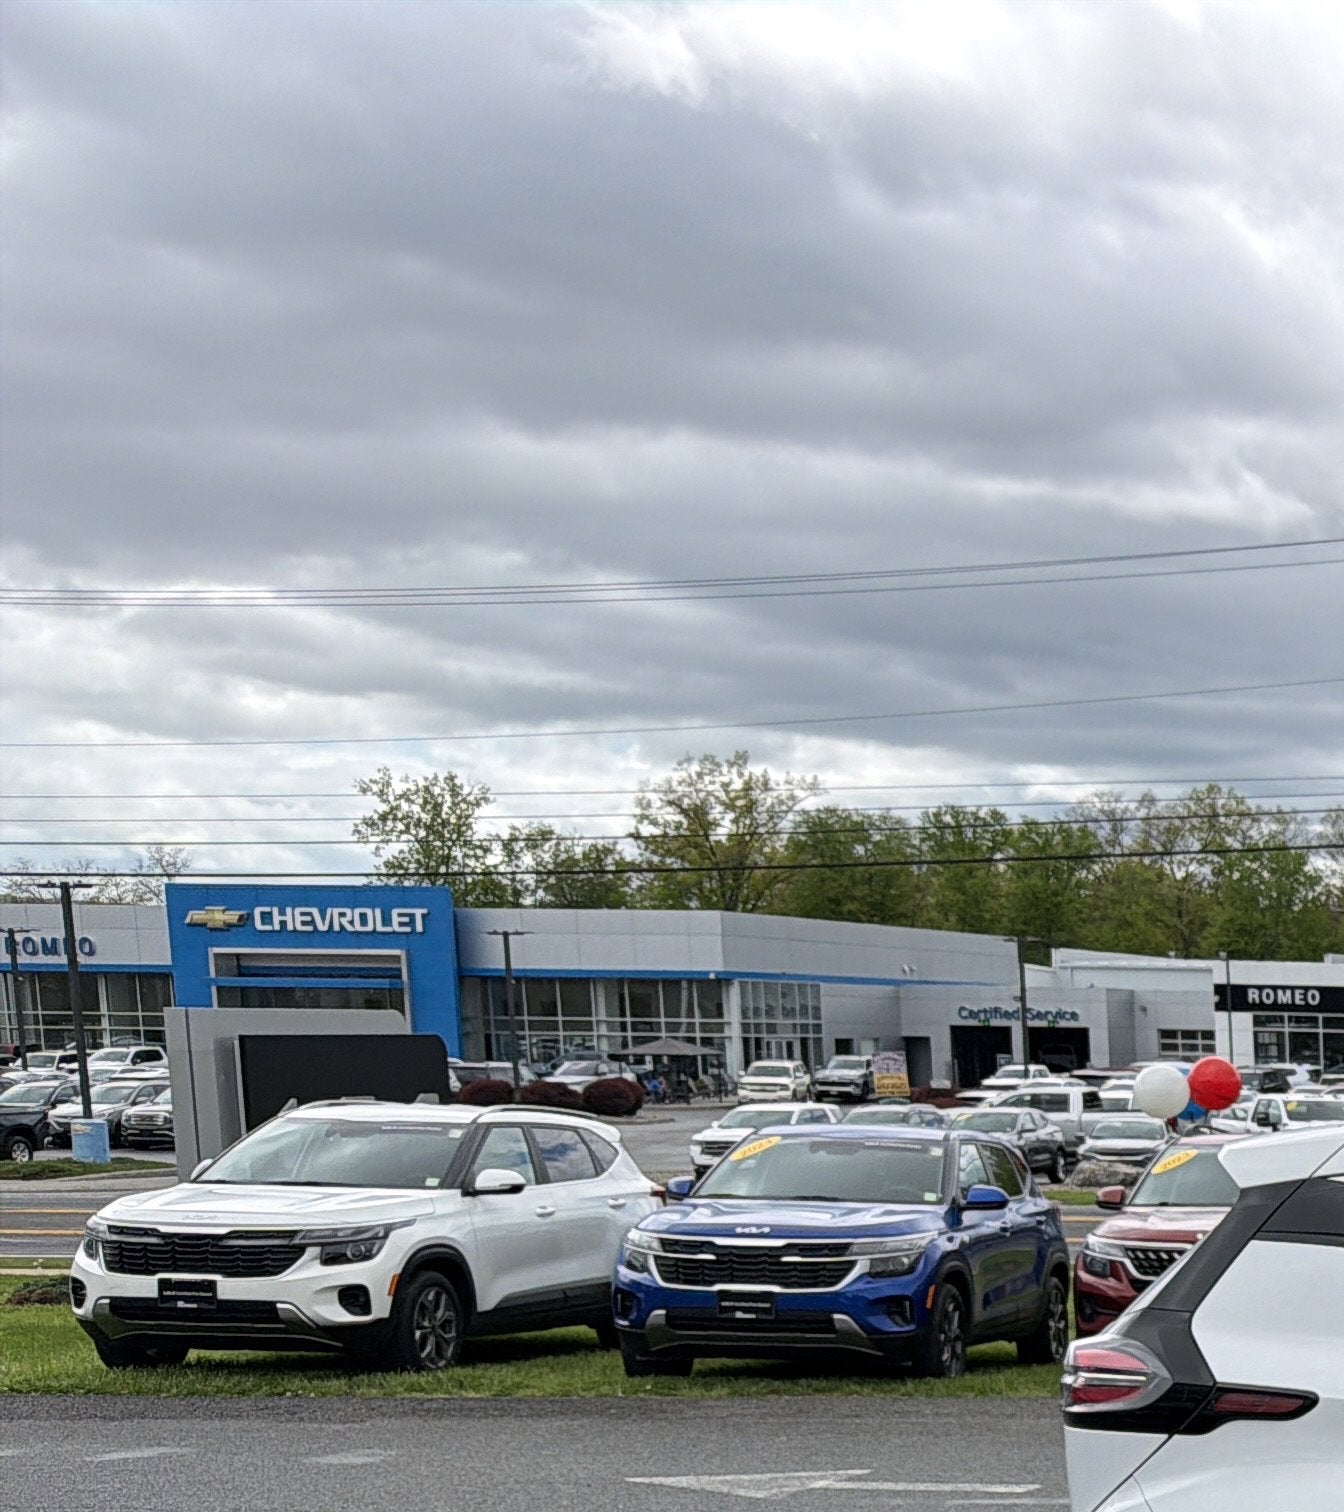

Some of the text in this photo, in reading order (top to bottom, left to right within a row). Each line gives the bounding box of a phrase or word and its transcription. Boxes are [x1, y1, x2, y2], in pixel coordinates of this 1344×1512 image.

[253, 906, 430, 933] CHEVROLET
[1247, 987, 1321, 1006] ROMEO
[958, 1005, 1080, 1022] Certified Service
